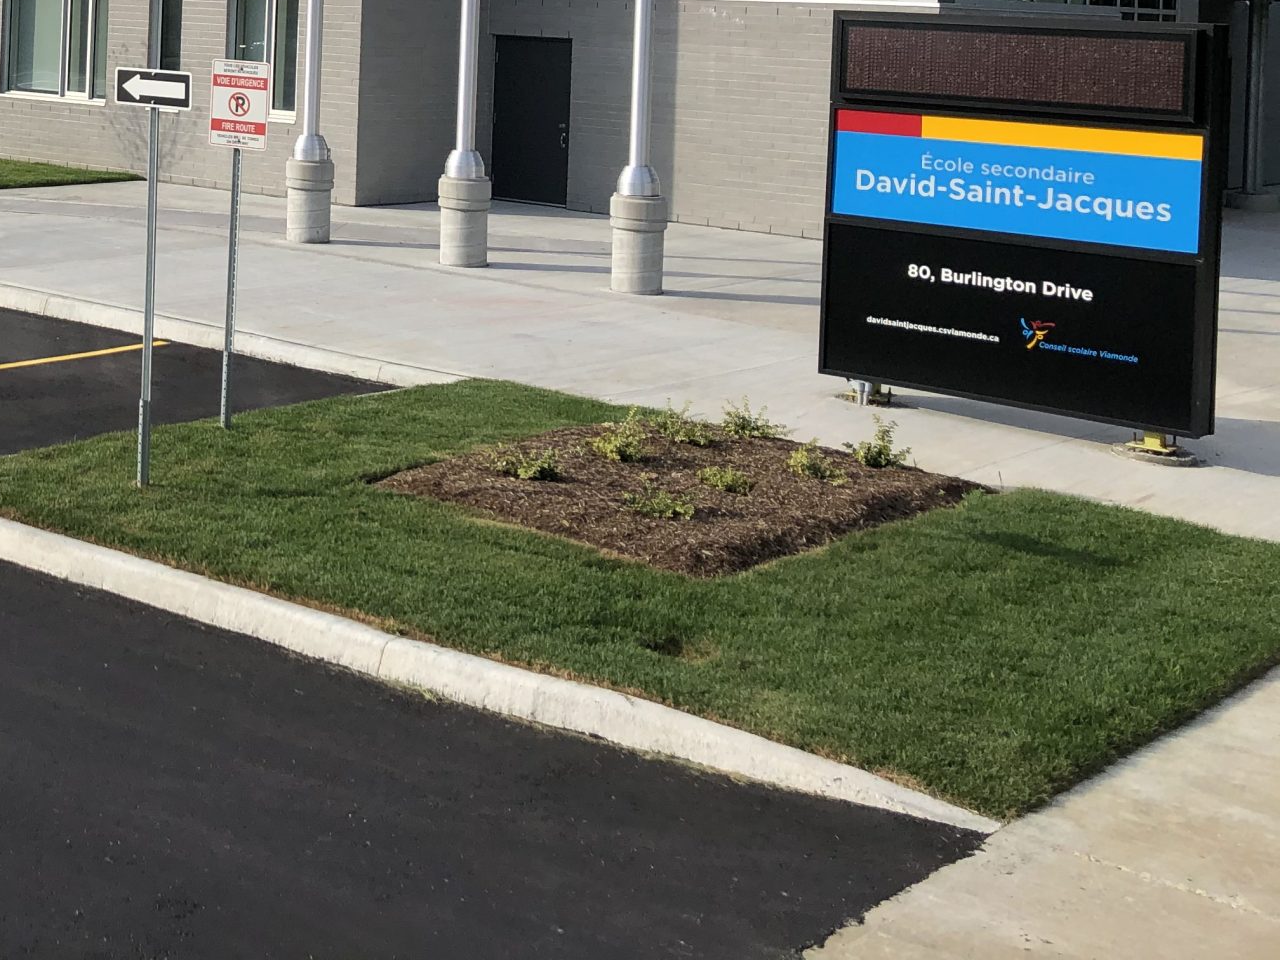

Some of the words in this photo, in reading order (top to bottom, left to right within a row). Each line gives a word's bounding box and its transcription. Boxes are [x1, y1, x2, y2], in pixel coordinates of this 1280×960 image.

[217, 76, 230, 84] VOIE
[231, 78, 264, 88] D'URGENCE
[221, 122, 235, 130] FIRE
[236, 124, 256, 132] ROUTE
[921, 150, 974, 174] École
[981, 160, 1095, 186] secondaire
[856, 169, 1172, 222] David-Saint-Jacques
[908, 264, 936, 282] 80,
[941, 267, 1037, 292] Burlington
[1042, 281, 1094, 302] Drive
[866, 315, 1000, 343] davidsaintjacques.csviamonde.ca
[1039, 341, 1067, 353] Conseil
[1068, 346, 1098, 358] scolaire
[1099, 349, 1138, 364] Viamonde
